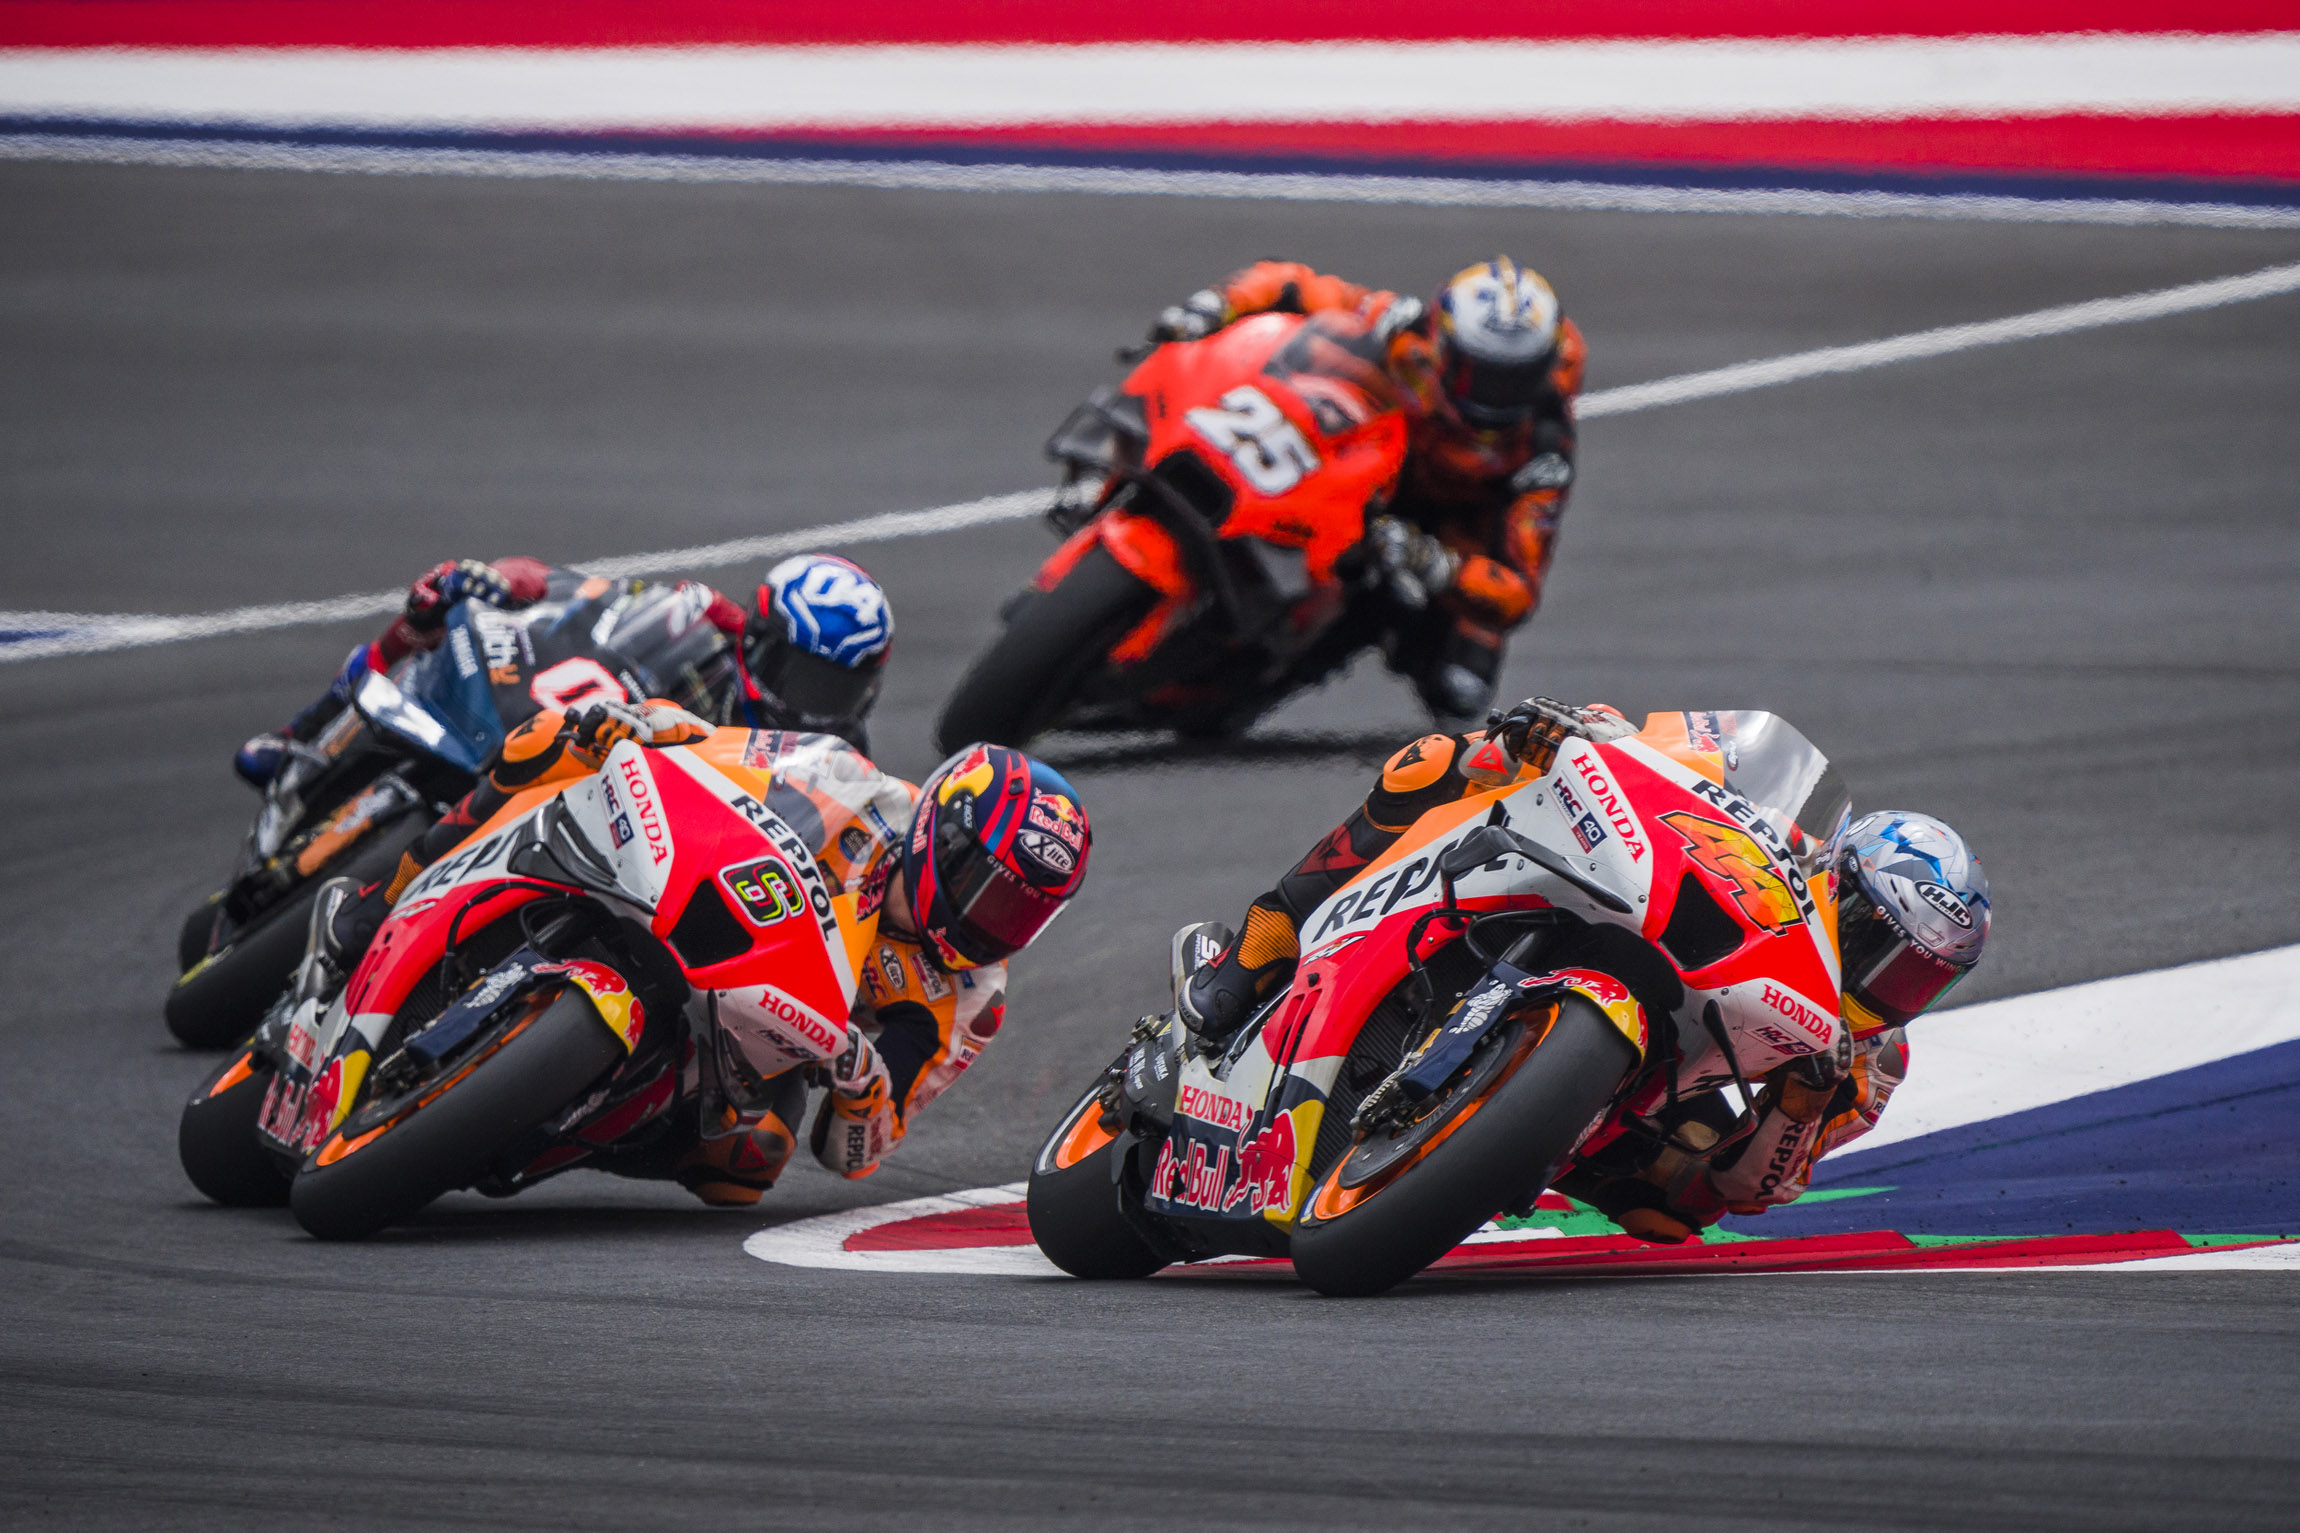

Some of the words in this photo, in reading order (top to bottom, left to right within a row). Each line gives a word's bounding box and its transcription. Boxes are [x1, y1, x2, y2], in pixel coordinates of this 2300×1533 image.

[1184, 385, 1322, 495] 25
[601, 774, 620, 816] HRC
[620, 757, 668, 866] HONDA
[1553, 777, 1583, 818] HRC
[1571, 752, 1645, 864] HONDA
[617, 819, 631, 841] 40
[1028, 805, 1064, 836] Red
[1060, 820, 1084, 851] Bull
[1029, 834, 1069, 869] X-lite
[1583, 820, 1601, 842] 40
[1692, 779, 1816, 925] REPSOL
[402, 823, 522, 900] REPS
[731, 795, 838, 942] REPSOL
[987, 855, 1014, 882] GIVES
[1019, 882, 1040, 899] YOU
[1311, 826, 1509, 943] REPS
[1876, 905, 1905, 938] GIVES
[1910, 939, 1933, 959] YOU
[1922, 886, 1970, 924] HJC
[759, 989, 838, 1053] HONDA
[1761, 984, 1833, 1044] HONDA
[1179, 1085, 1243, 1131] HONDA
[1186, 1143, 1230, 1212] Bull
[1755, 1119, 1807, 1199] REPSOL
